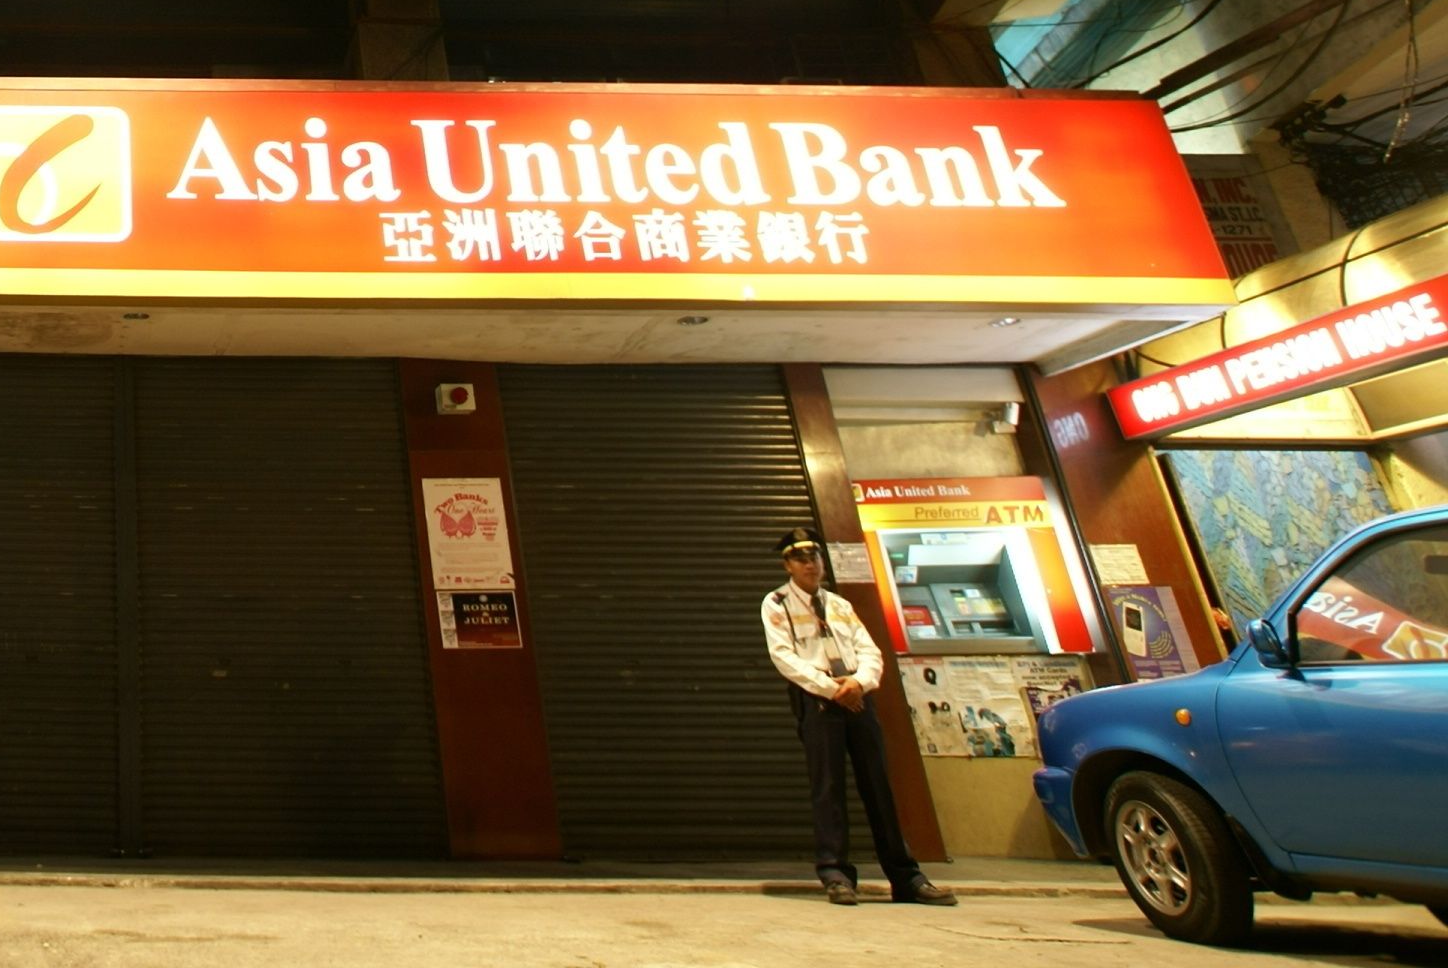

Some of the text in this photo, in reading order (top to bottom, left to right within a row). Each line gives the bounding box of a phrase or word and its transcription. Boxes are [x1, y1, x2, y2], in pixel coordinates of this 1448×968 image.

[166, 115, 1068, 209] Asia United Bank
[378, 209, 871, 266] 亞洲聯合商業銀行
[1223, 327, 1343, 395] PENSION
[1335, 292, 1448, 360] HOUSE
[454, 493, 489, 505] Banks
[866, 484, 972, 499] Asia United Bank
[914, 504, 1045, 524] Preferred ATM
[461, 603, 508, 612] ROMEO
[463, 616, 510, 625] JULIET
